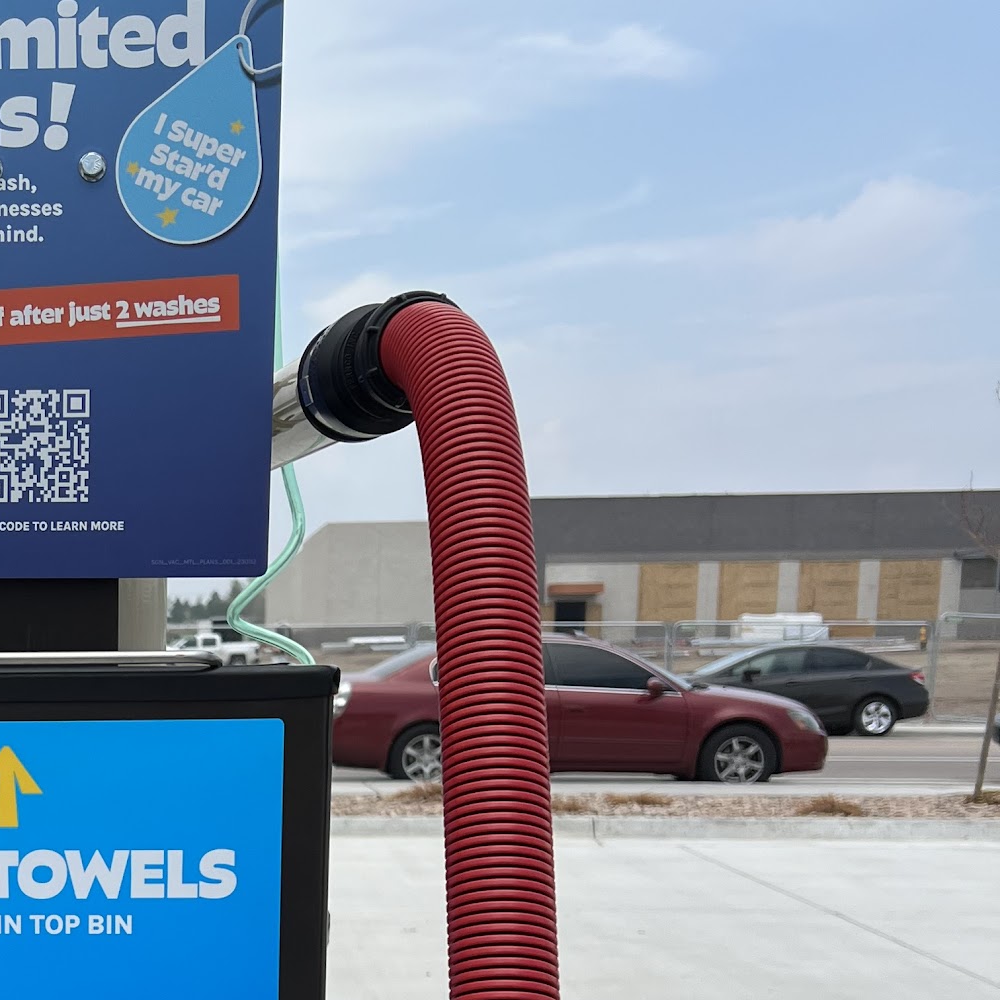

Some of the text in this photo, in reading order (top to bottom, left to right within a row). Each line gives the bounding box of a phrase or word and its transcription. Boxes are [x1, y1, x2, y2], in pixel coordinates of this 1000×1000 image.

[153, 112, 168, 135] I
[134, 167, 223, 216] my car
[9, 304, 64, 326] after
[68, 301, 111, 328] just
[115, 300, 130, 320] 2
[133, 294, 221, 319] washes
[0, 521, 30, 532] CODE
[32, 521, 48, 531] TO
[50, 521, 88, 531] LEARN
[90, 521, 125, 531] MORE
[30, 914, 81, 935] TOP
[88, 914, 133, 935] BIN
